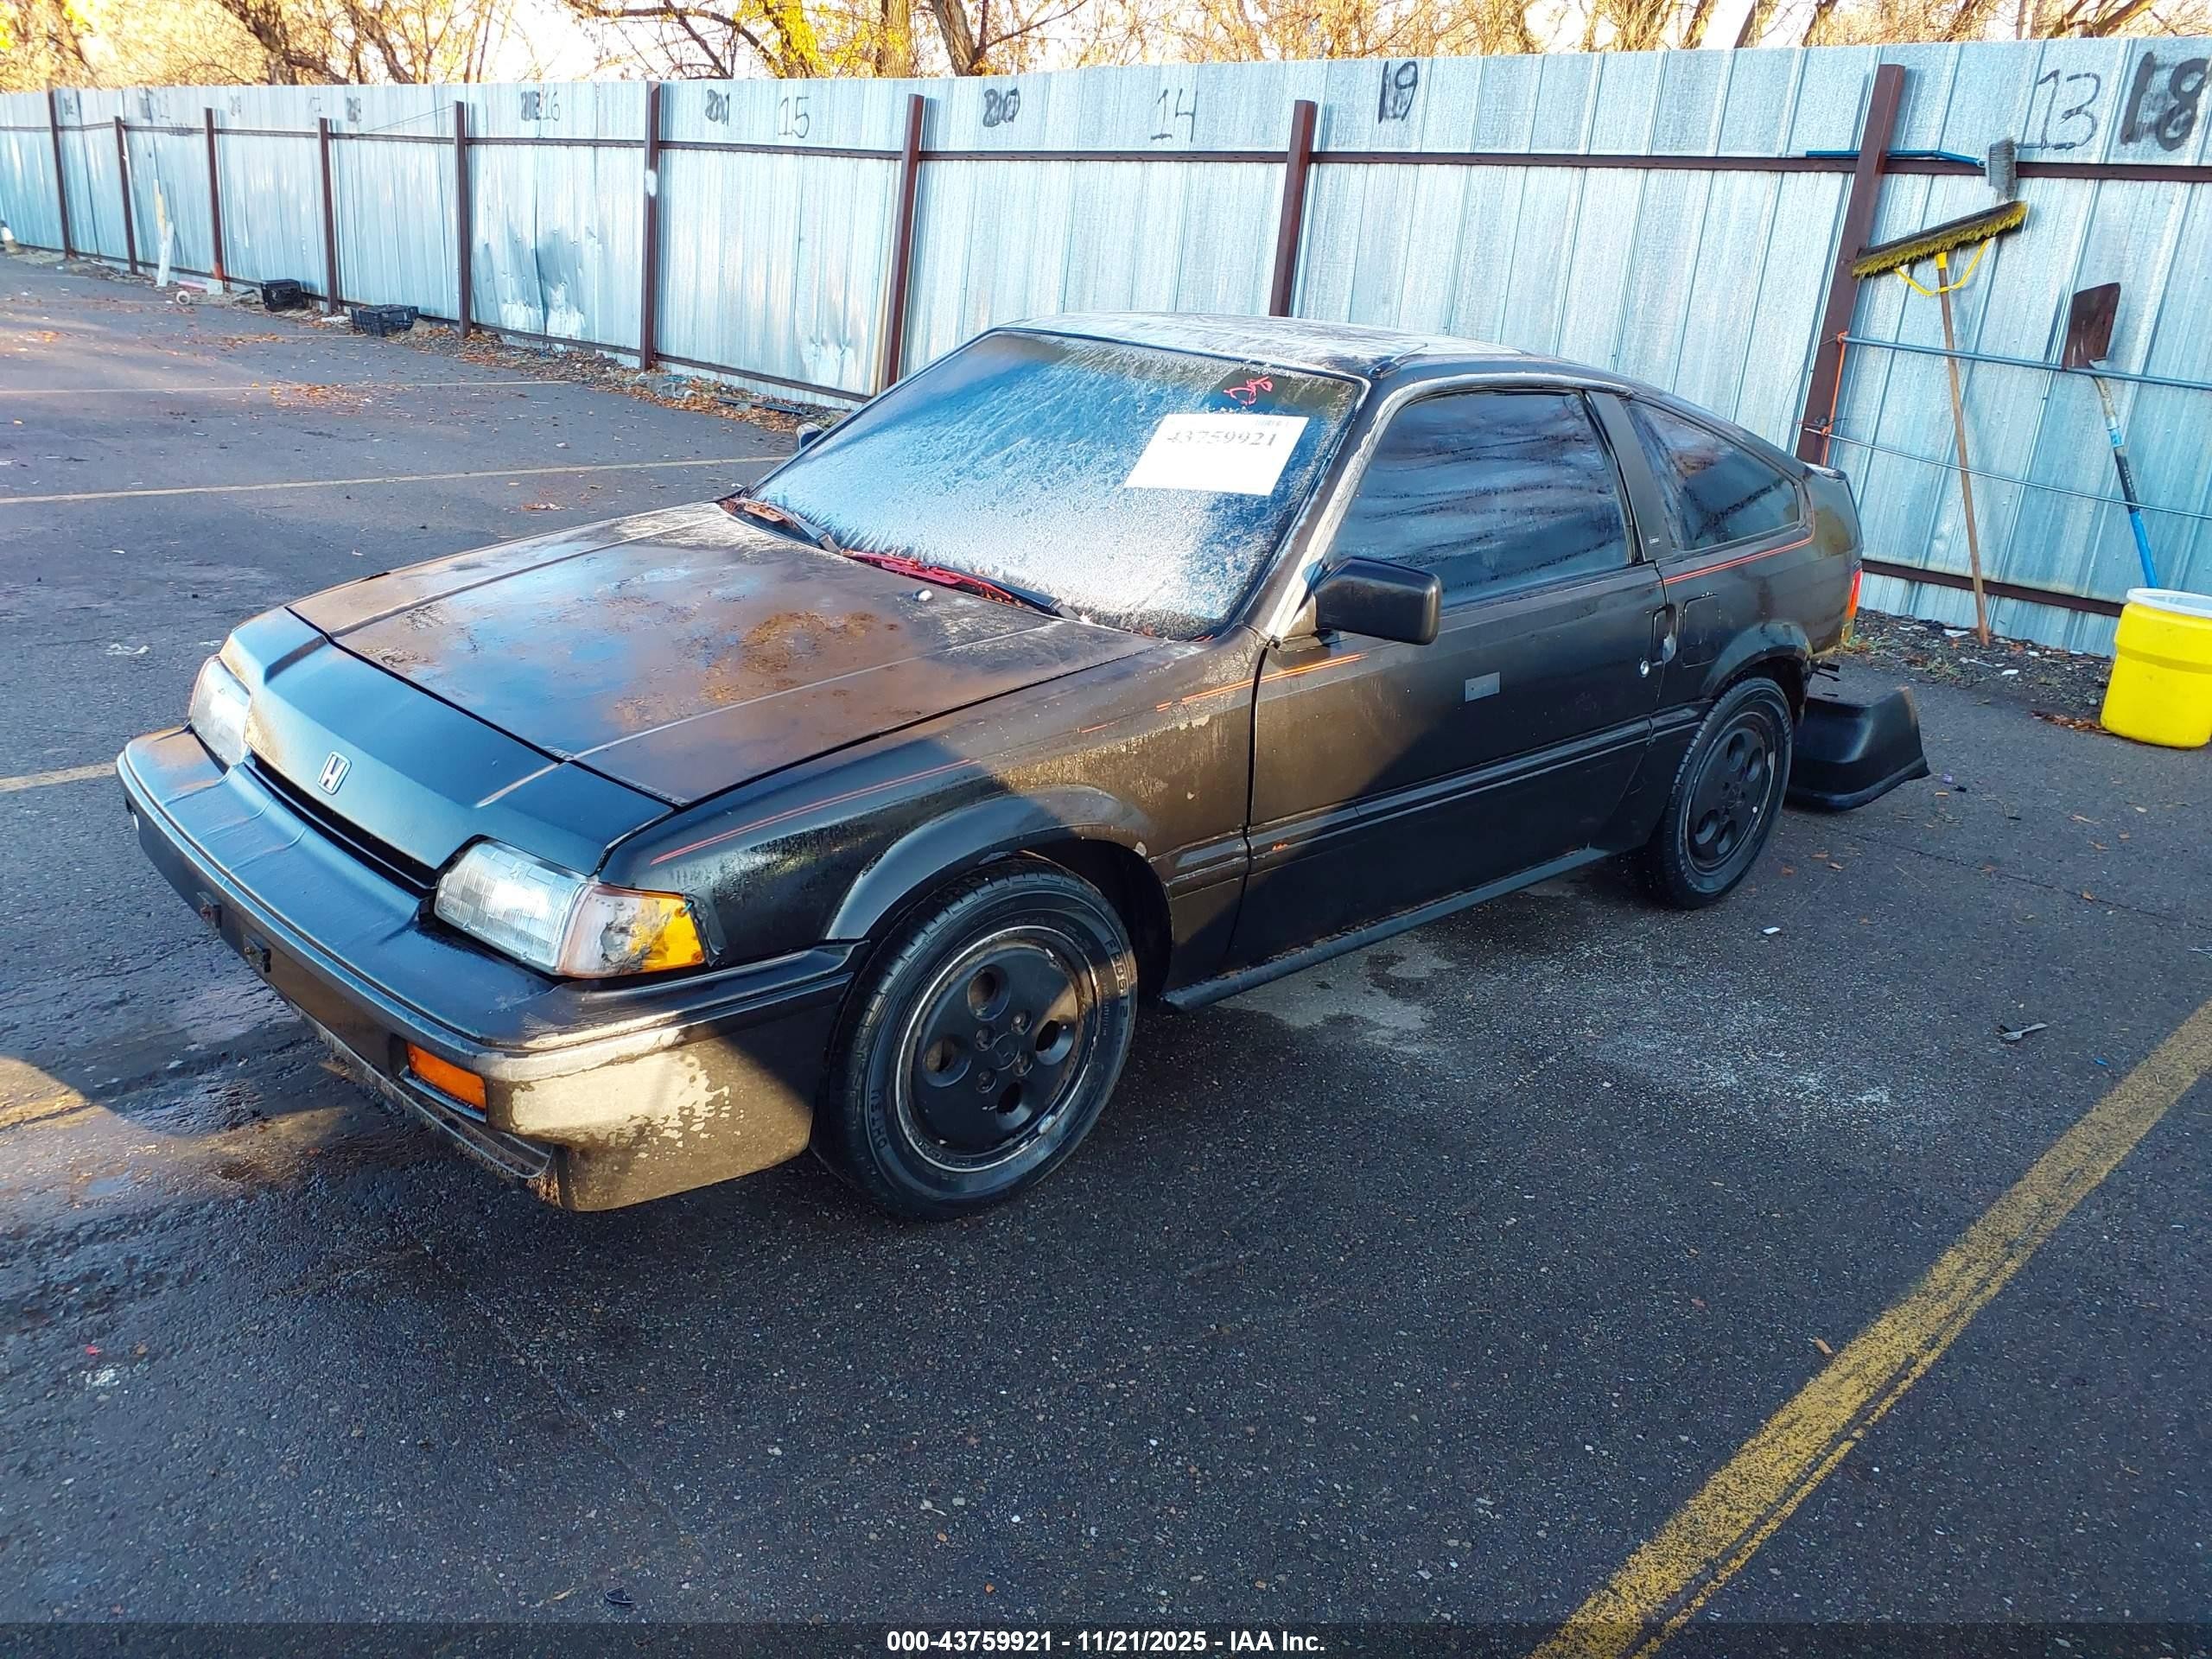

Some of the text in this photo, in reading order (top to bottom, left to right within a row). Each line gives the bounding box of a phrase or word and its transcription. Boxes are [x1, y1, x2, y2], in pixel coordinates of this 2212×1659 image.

[778, 96, 810, 138] 15
[1150, 88, 1198, 143] 14
[2018, 68, 2101, 150] 13
